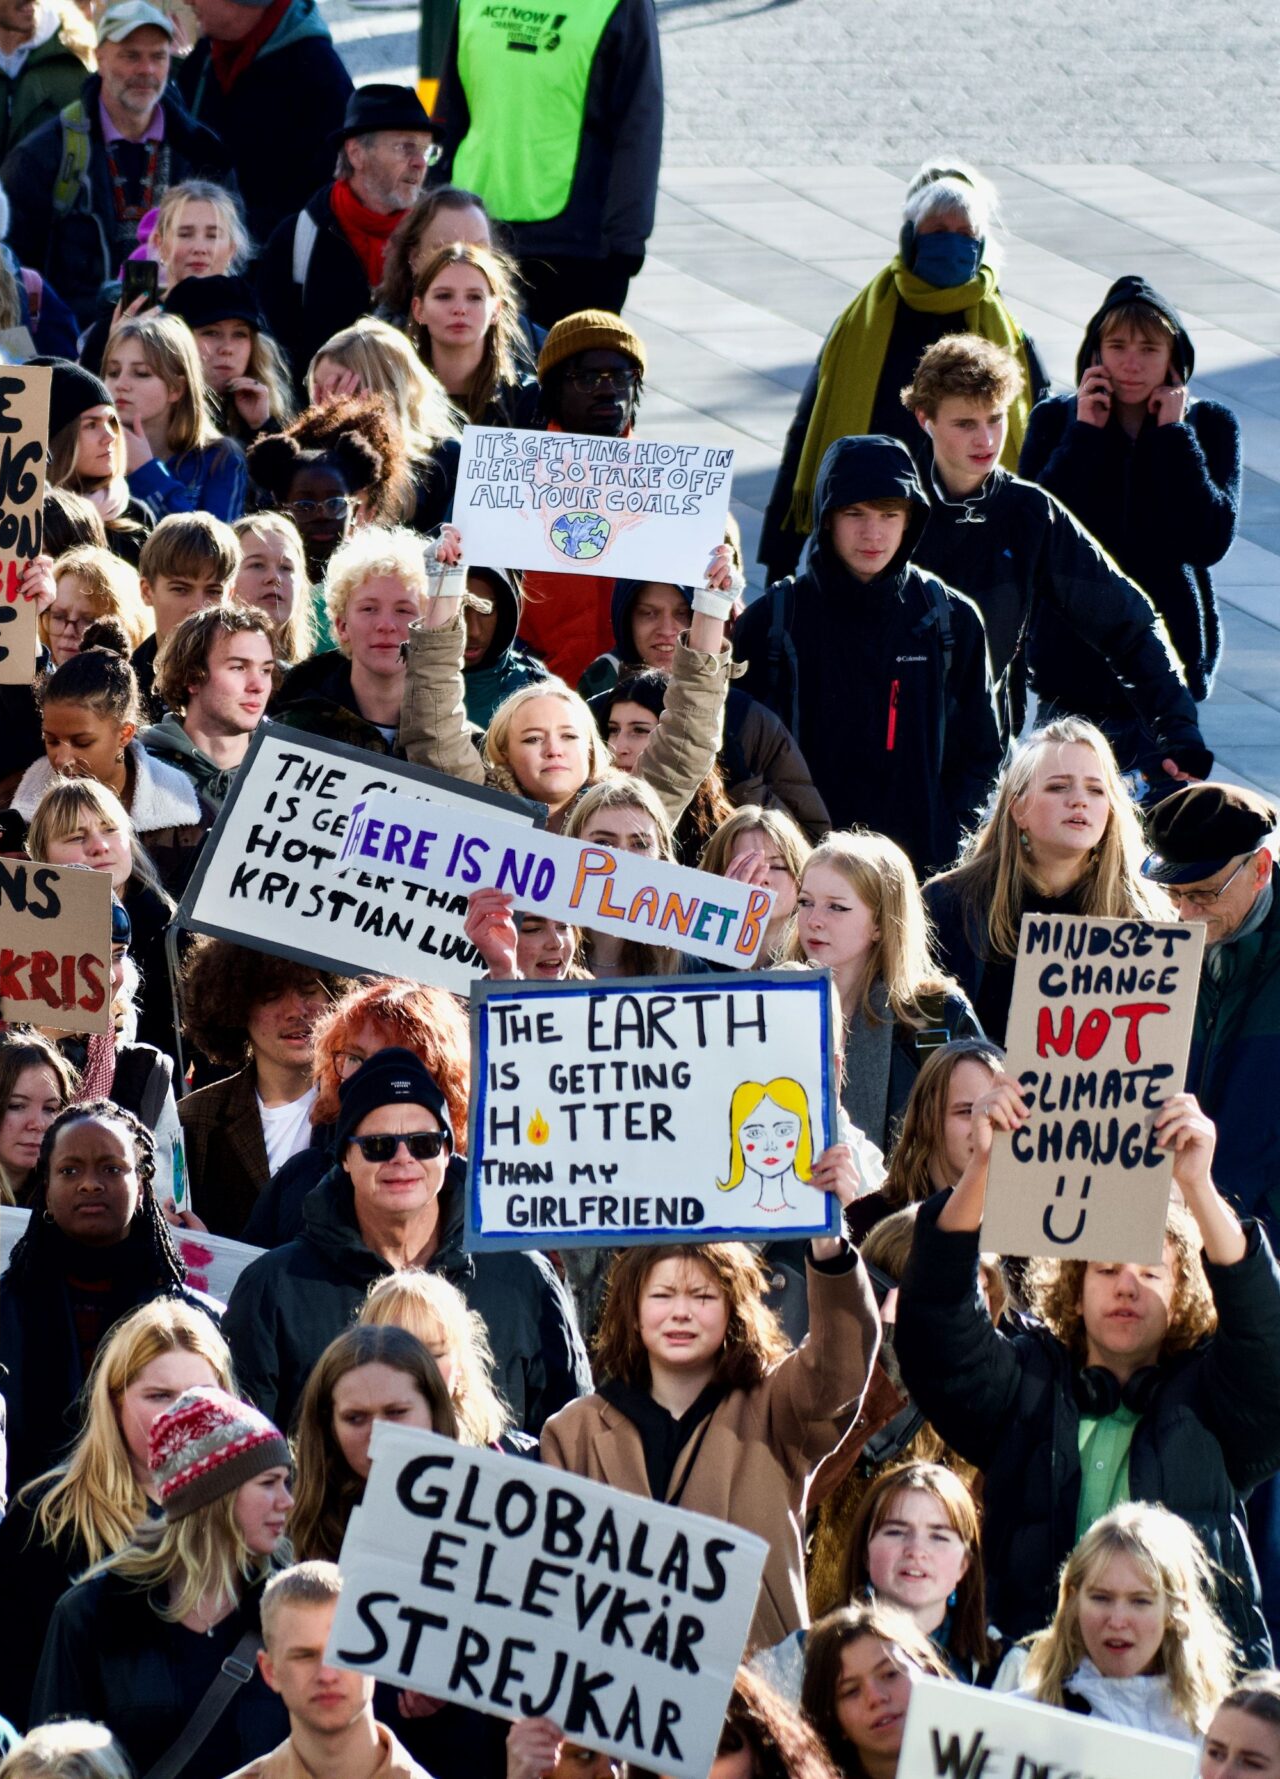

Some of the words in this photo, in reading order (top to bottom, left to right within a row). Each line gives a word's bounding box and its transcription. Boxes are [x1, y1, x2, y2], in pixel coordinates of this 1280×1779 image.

[481, 5, 509, 19] ACT
[521, 436, 630, 464] GETTING
[635, 442, 698, 468] HOT
[703, 449, 734, 469] IN
[466, 457, 538, 483] HERE
[546, 459, 585, 484] SO
[589, 464, 664, 490] TAKE
[668, 468, 725, 496] OFF
[470, 484, 524, 509] ALL
[528, 483, 601, 510] YOUR
[275, 753, 347, 800] THE
[264, 792, 300, 823] IS
[340, 801, 438, 871] THERE
[445, 833, 491, 884] IS
[495, 848, 556, 903] NO
[568, 848, 739, 947] PLANET
[735, 889, 772, 957] B
[402, 880, 470, 917] THA
[229, 862, 414, 942] KRISTIAN
[1026, 921, 1192, 961] MINDSET
[1039, 963, 1180, 998] CHANGE
[490, 1004, 563, 1047] THE
[587, 994, 768, 1052] EARTH
[1036, 1002, 1171, 1065] NOT
[490, 1062, 520, 1091] IS
[548, 1062, 692, 1095] GETTING
[1018, 1064, 1175, 1114] CLIMATE
[1011, 1118, 1167, 1170] CHANGE
[482, 1159, 554, 1187] THAN
[569, 1163, 619, 1185] MY
[506, 1195, 706, 1228] GIRLFRIEND
[396, 1455, 736, 1602] GLOBALAS
[420, 1531, 705, 1675] ELEVKÅR
[337, 1592, 685, 1762] STREJKAR
